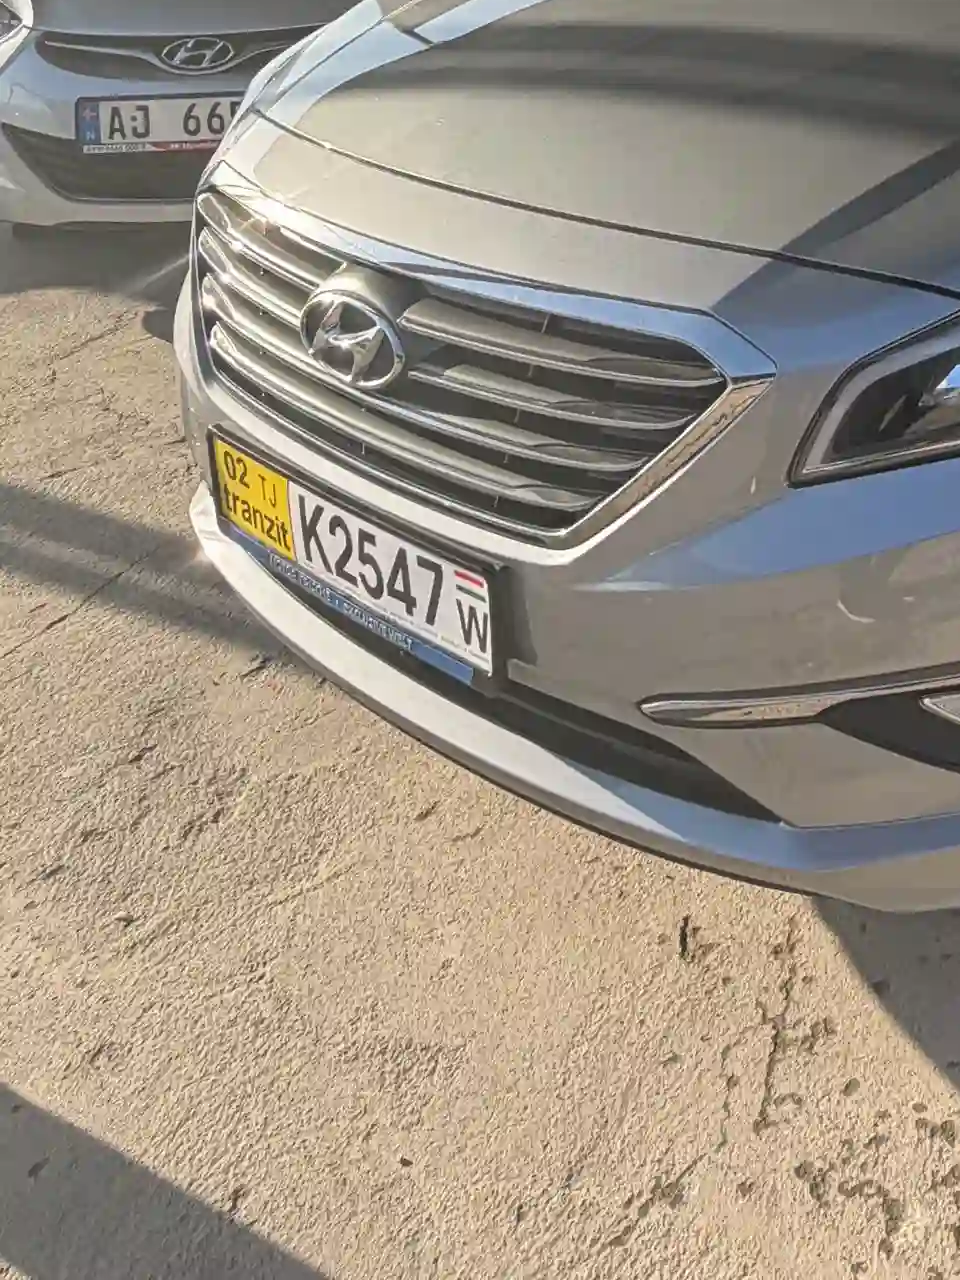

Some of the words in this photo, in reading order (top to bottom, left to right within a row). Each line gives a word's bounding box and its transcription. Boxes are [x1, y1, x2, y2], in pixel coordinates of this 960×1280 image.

[223, 450, 250, 489] 02
[257, 473, 277, 508] TJ
[223, 483, 291, 552] tranzit
[298, 492, 443, 626] K2547
[455, 597, 488, 654] W
